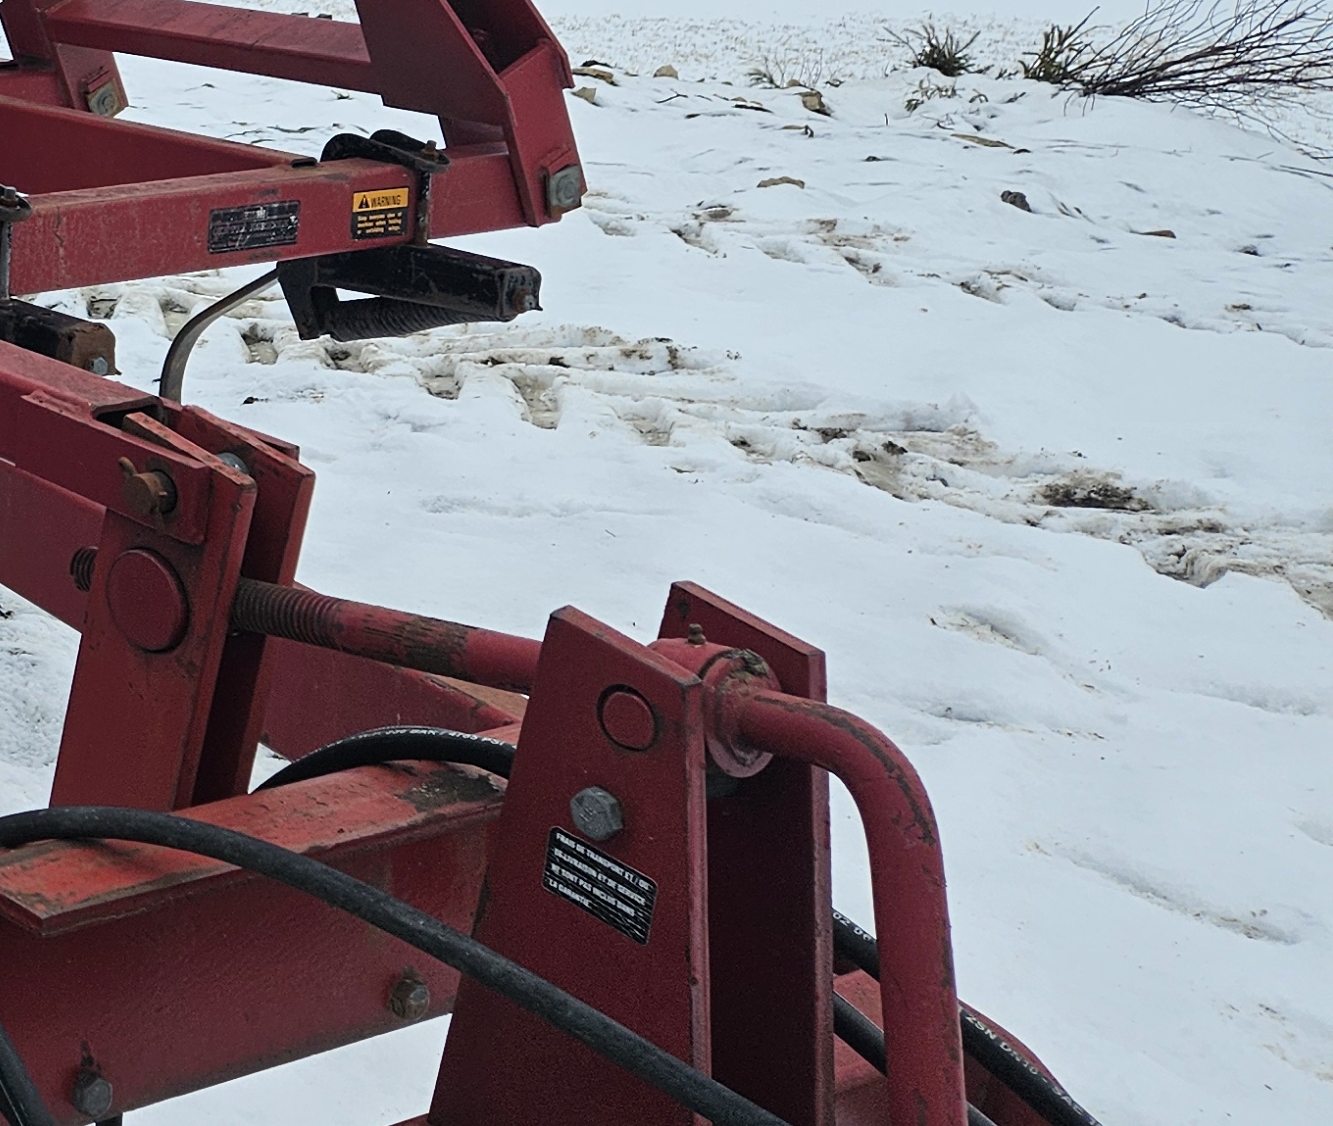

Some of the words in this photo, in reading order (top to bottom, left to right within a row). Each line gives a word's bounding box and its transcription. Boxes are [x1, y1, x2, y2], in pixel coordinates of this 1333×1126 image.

[556, 833, 576, 849] FRAIS
[586, 849, 625, 876] TRANSPORT
[549, 878, 558, 888] LA
[579, 879, 592, 891] PAS
